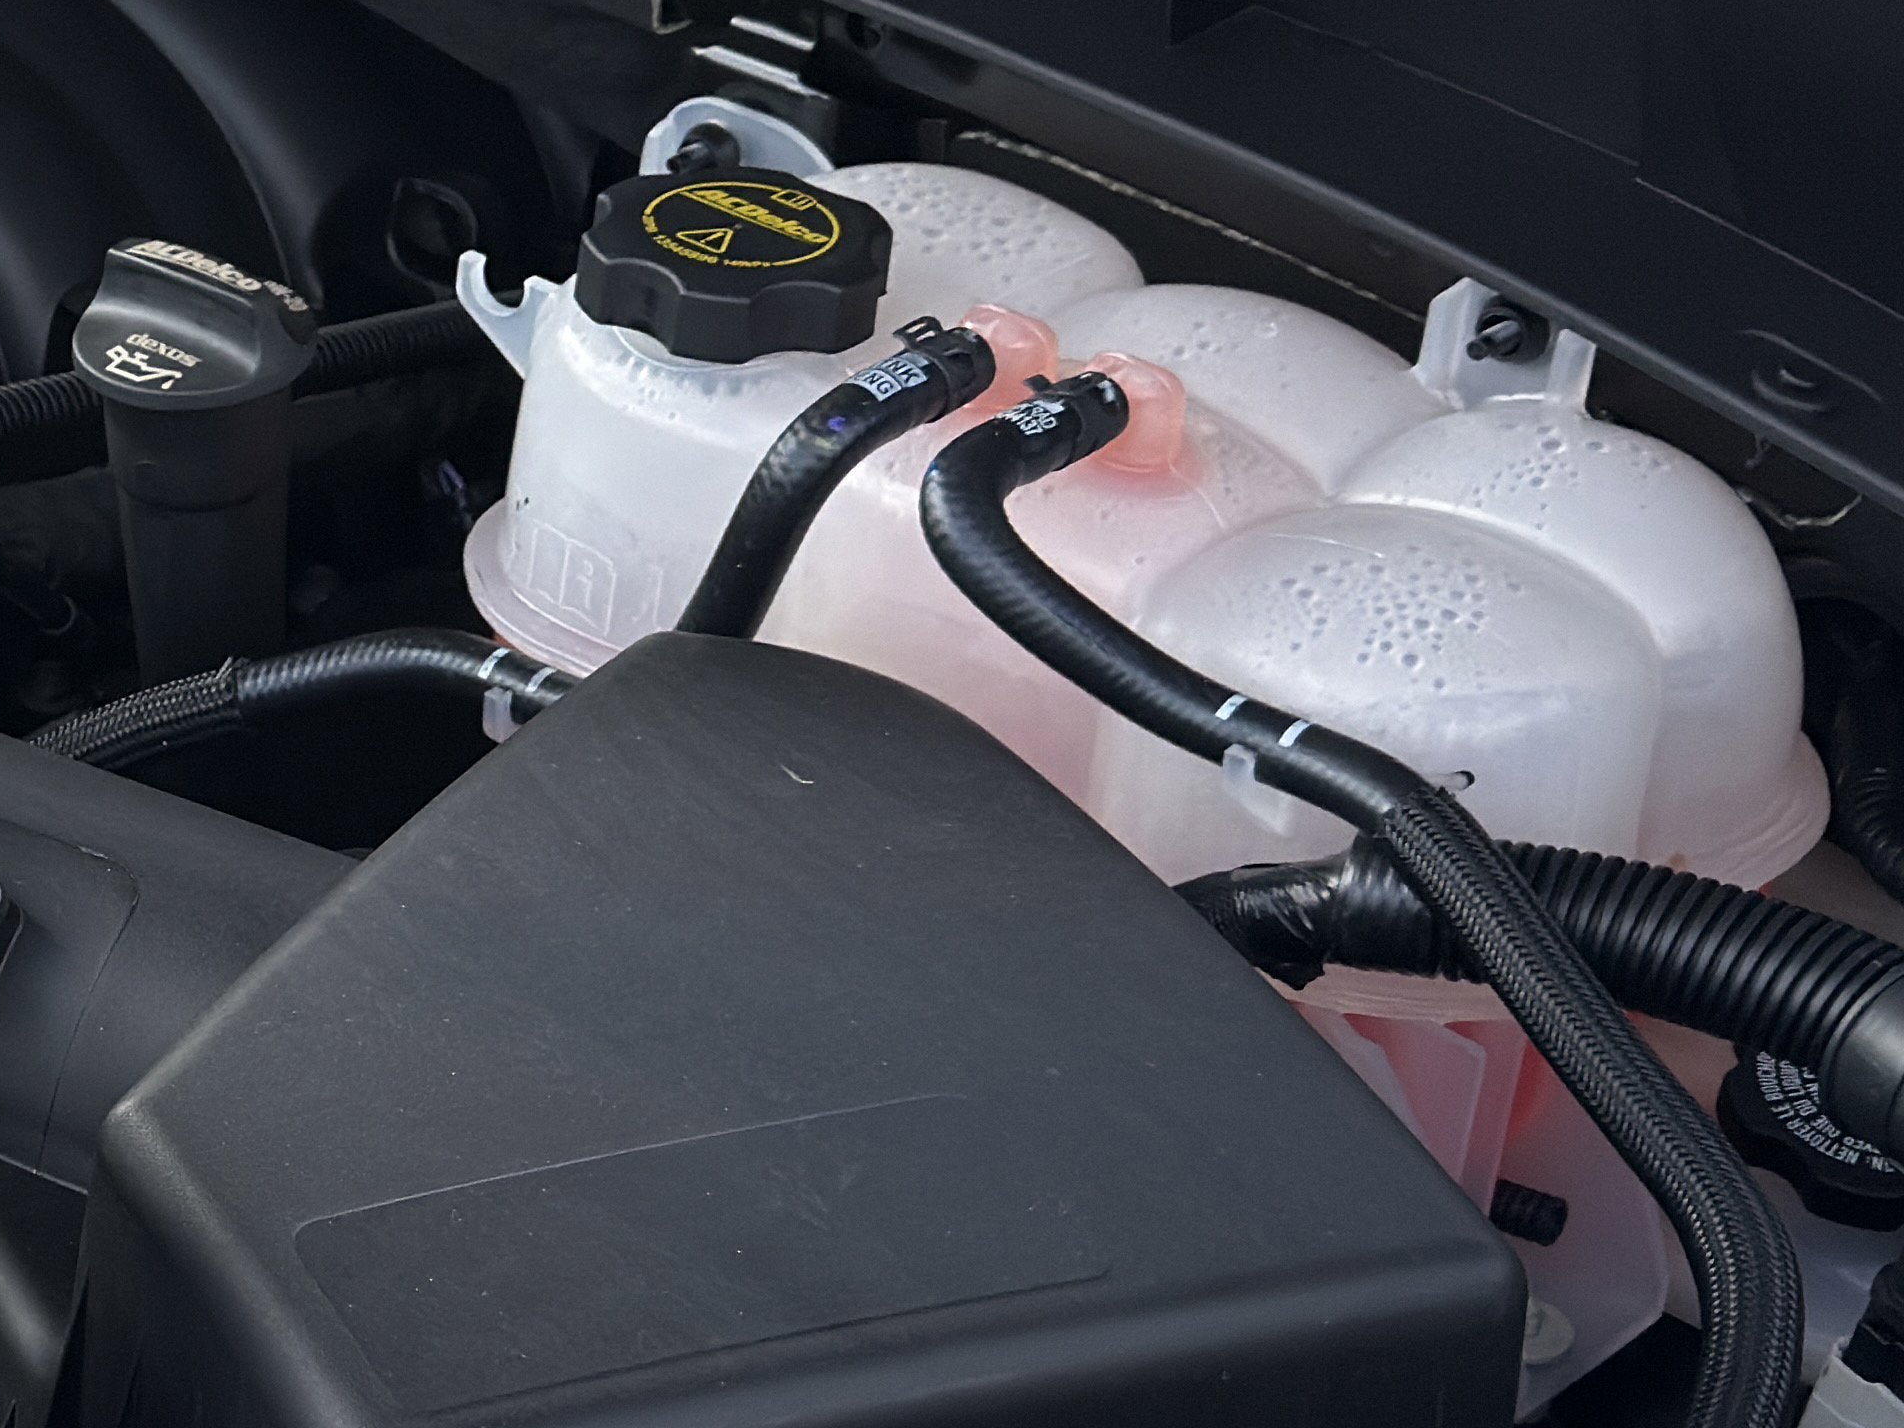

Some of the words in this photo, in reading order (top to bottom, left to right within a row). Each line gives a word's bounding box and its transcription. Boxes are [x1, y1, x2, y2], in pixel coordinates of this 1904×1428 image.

[682, 180, 830, 243] ACDelco
[126, 332, 202, 368] dexos
[1770, 1102, 1795, 1120] LE
[1786, 1118, 1860, 1165] NETTOYER
